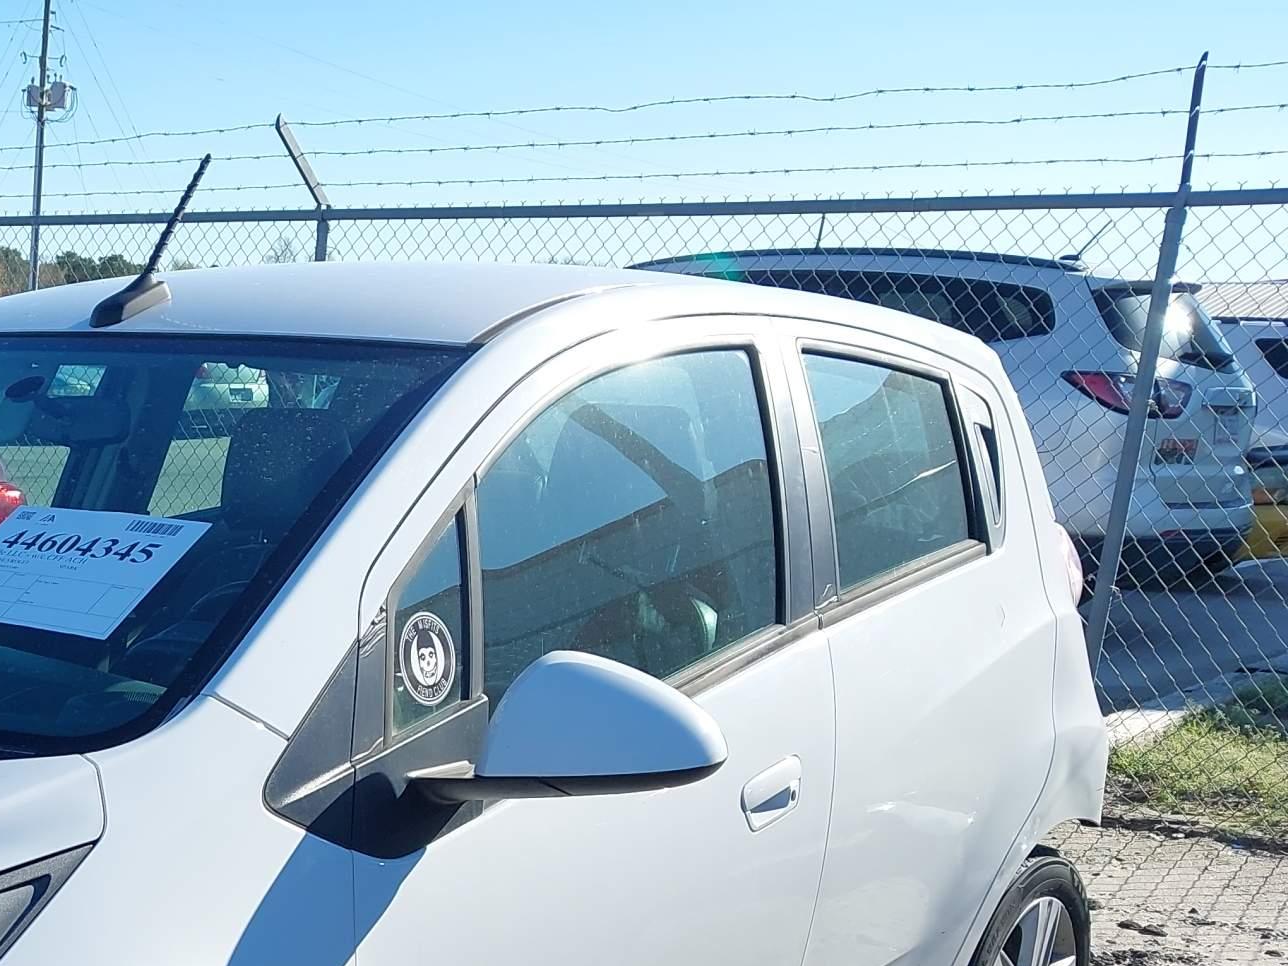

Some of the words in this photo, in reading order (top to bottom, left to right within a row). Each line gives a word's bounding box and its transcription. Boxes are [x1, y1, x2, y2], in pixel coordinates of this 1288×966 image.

[2, 529, 164, 564] 44604345
[405, 626, 417, 642] THE
[417, 619, 440, 634] MISFITS
[416, 685, 433, 698] FIEND
[433, 678, 448, 697] CLUB
